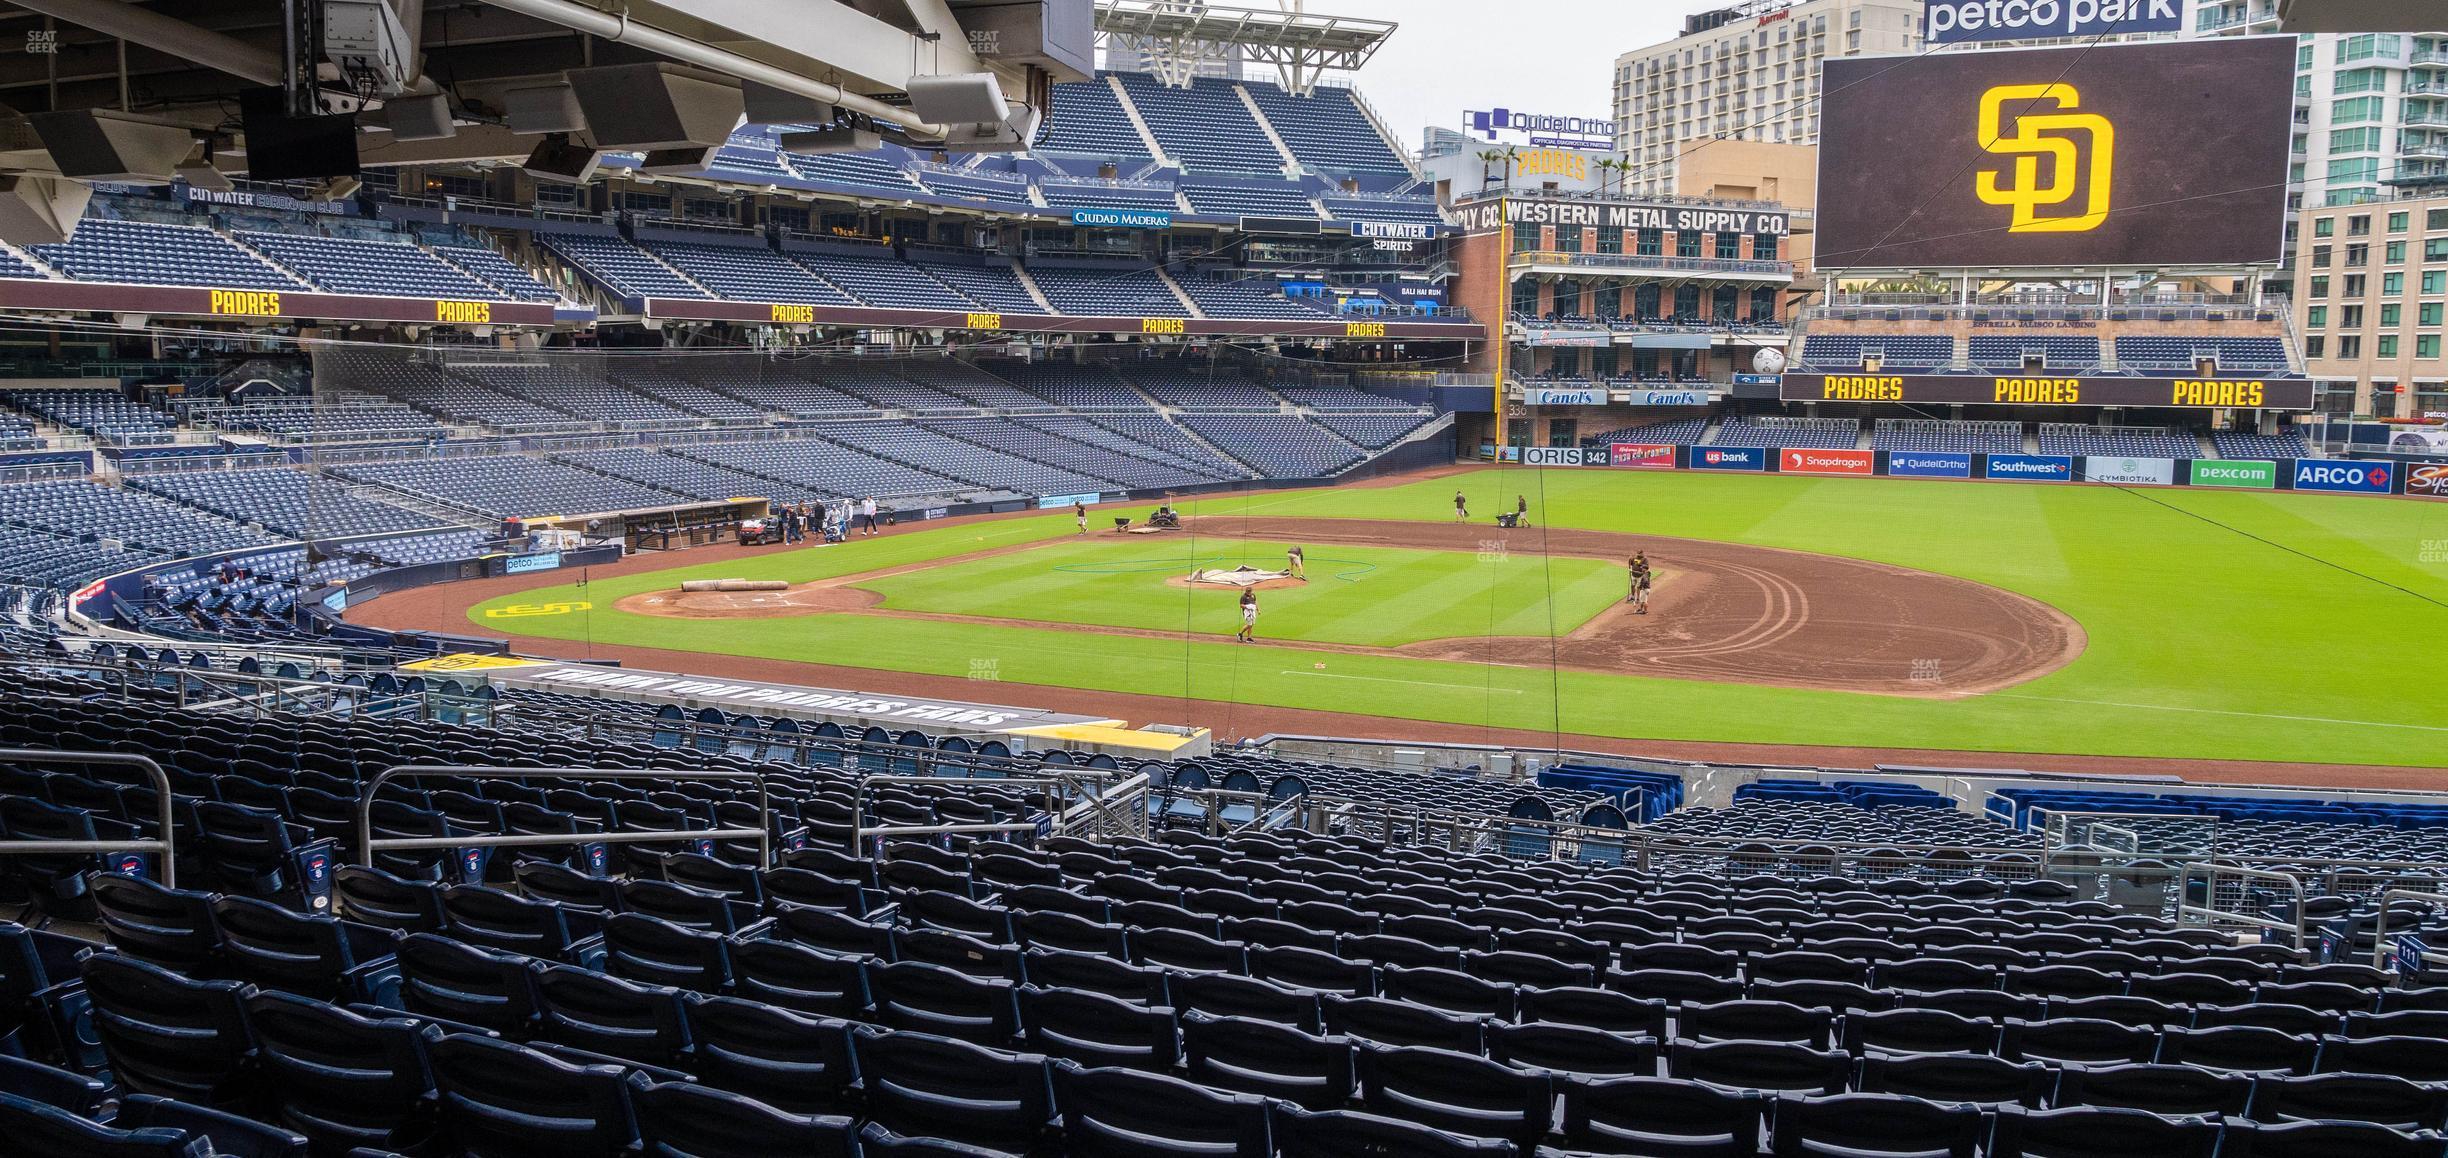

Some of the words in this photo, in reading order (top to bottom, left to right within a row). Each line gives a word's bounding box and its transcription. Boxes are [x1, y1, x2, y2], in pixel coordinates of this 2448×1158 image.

[1928, 0, 2059, 41] petco
[2068, 0, 2177, 34] park
[1513, 112, 1616, 135] QuidelOrtho
[1517, 149, 1585, 181] PADRES
[1482, 204, 1501, 228] CO.
[1506, 201, 1599, 225] WESTERN
[1609, 207, 1672, 229] METAL
[1678, 211, 1750, 233] SUPPLY
[1757, 214, 1787, 234] CO.
[1361, 223, 1426, 238] CUTWATER
[1373, 241, 1413, 251] SPIRITS
[211, 290, 280, 315] PADRES
[437, 301, 490, 322] PADRES
[772, 305, 813, 322] PADRES
[967, 314, 1000, 329] PADRES
[1143, 319, 1184, 333] PADRES
[1347, 323, 1384, 336] PADRES
[1824, 376, 1903, 400] PADRES
[1994, 378, 2079, 403] PADRES
[2172, 381, 2264, 407] PADRES
[1541, 390, 1592, 404] Canel's
[1645, 391, 1695, 405] Canel's
[1508, 404, 1527, 416] 336
[1527, 449, 1580, 465] ORIS
[1587, 452, 1606, 463] 342
[1707, 452, 1720, 461] us
[1721, 451, 1748, 462] bank
[1806, 456, 1866, 468] Snapdragon
[1908, 459, 1967, 470] QuidelOrtho
[1992, 461, 2056, 474] Southwest
[2099, 474, 2158, 483] CYMBIOTIKA
[2297, 465, 2364, 485] ARCO
[507, 559, 532, 569] petco
[529, 668, 679, 689] THANK
[653, 680, 755, 696] YOU
[728, 686, 908, 714] PADRES
[892, 705, 1020, 725] FANS
[1040, 821, 1051, 834] 111
[2401, 945, 2416, 963] 111
